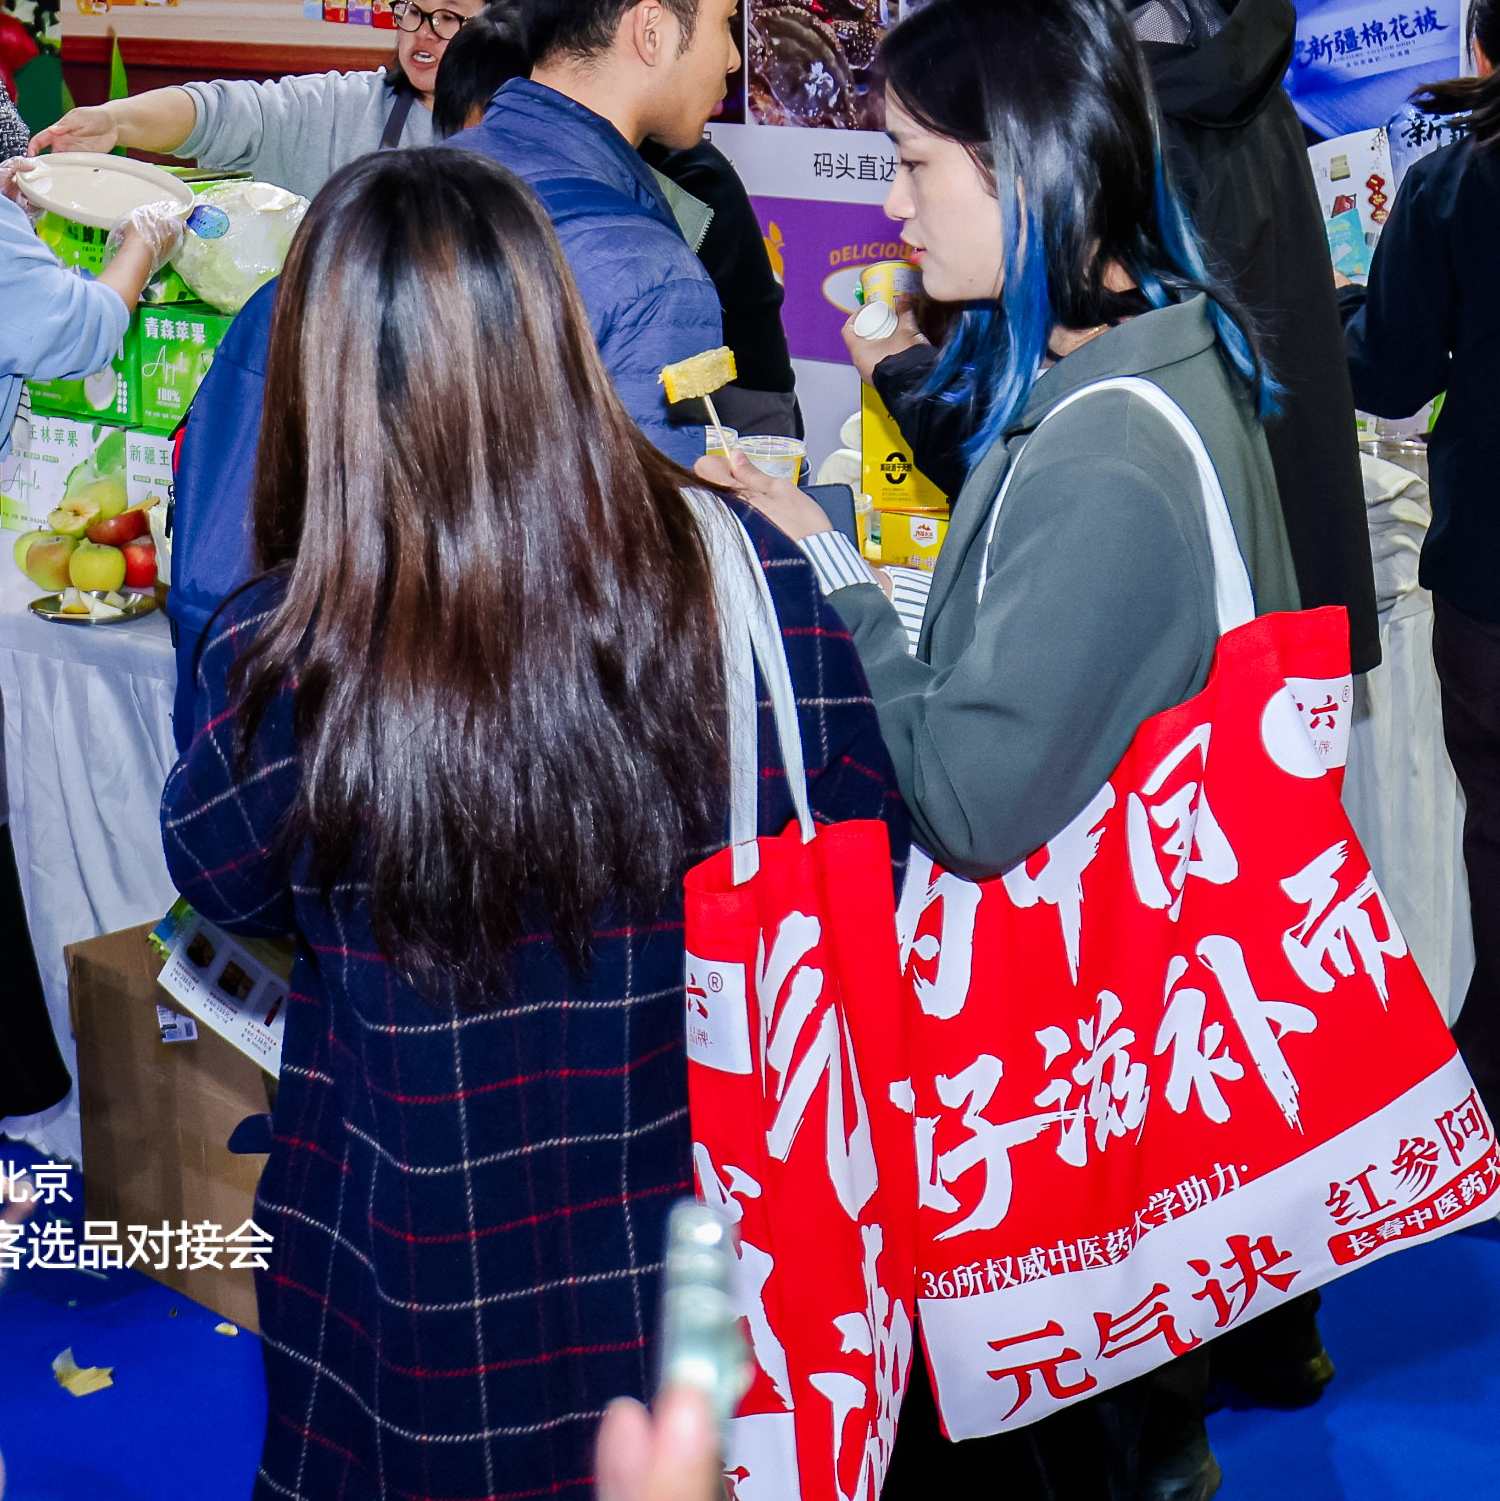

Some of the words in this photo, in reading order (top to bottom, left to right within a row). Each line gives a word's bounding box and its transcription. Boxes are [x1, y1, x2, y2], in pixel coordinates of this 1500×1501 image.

[1308, 6, 1449, 65] 新疆棉花被
[813, 151, 901, 184] 码头直达
[145, 316, 206, 344] 青森苹果
[1324, 1087, 1495, 1226] 红参阿
[986, 1233, 1300, 1422] 元气诀
